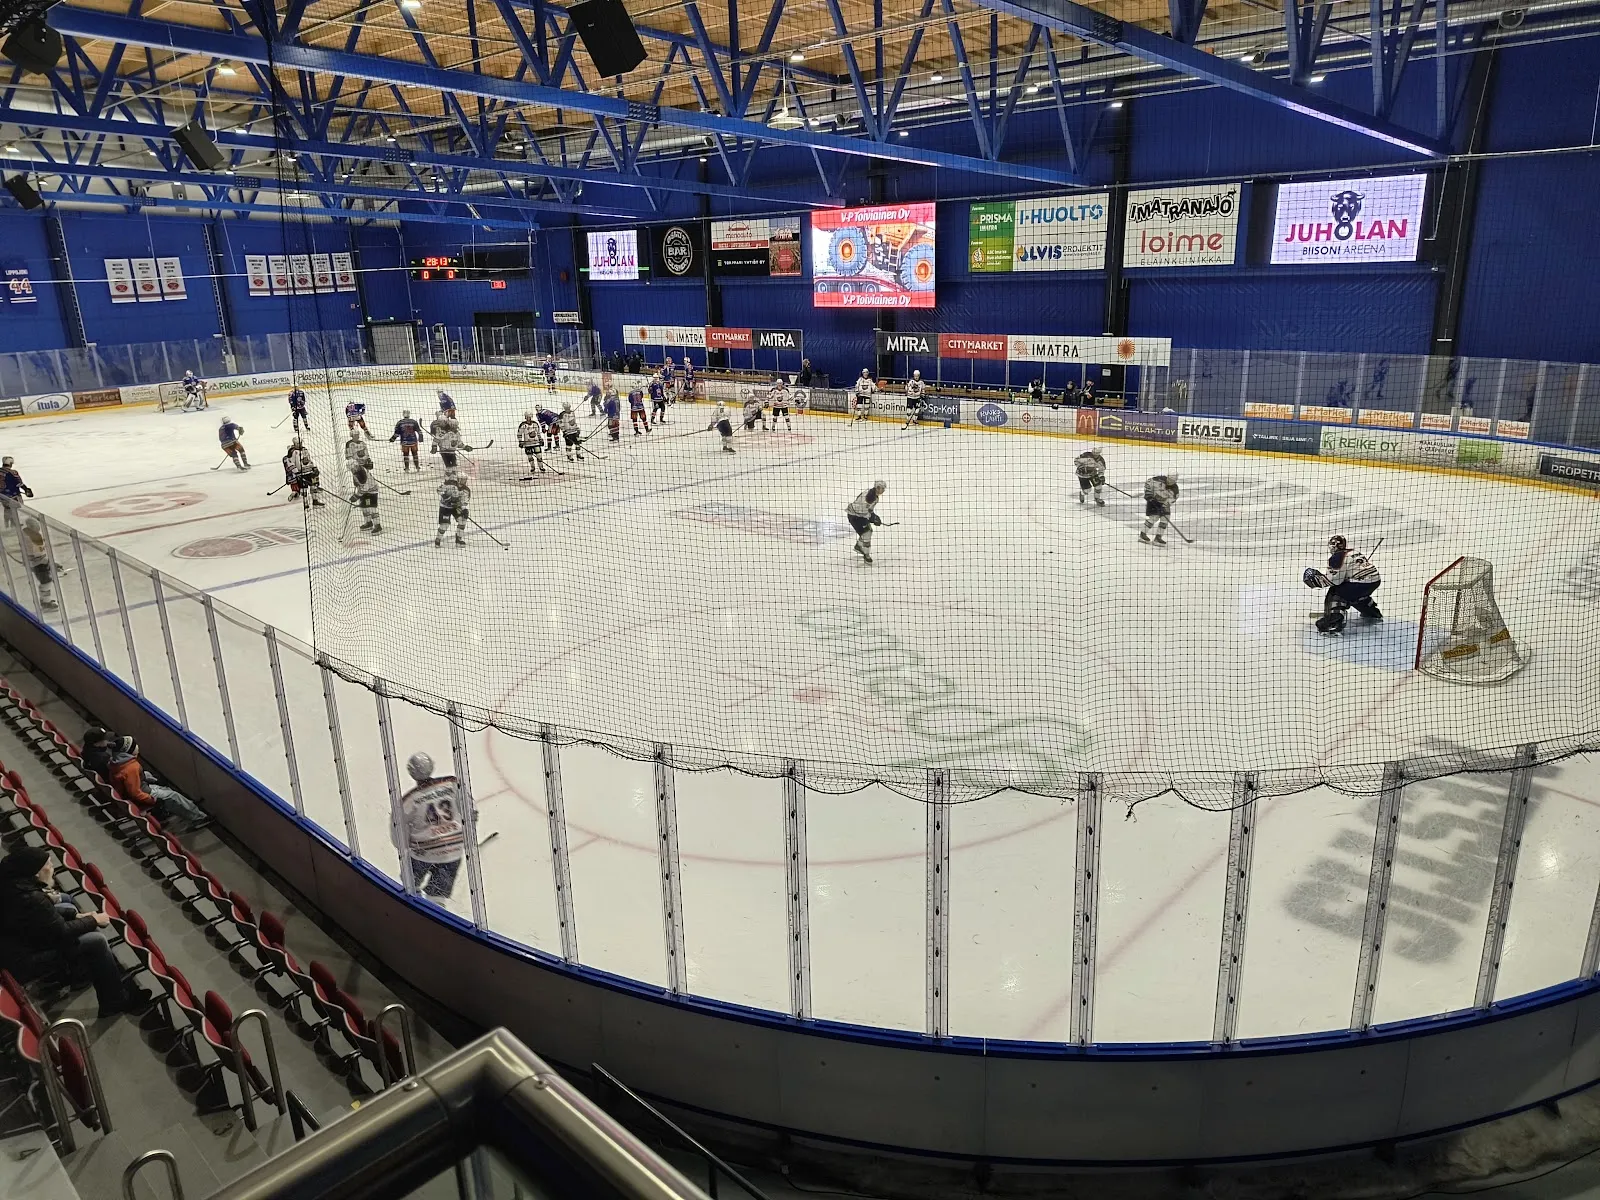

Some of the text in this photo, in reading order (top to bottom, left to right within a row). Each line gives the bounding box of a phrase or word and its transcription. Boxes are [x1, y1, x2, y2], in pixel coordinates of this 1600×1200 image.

[1129, 193, 1234, 223] IMATRANAJO
[841, 208, 910, 222] V-P Toiviainen Oy
[980, 213, 1013, 224] PRISMA
[1285, 218, 1408, 242] JUHOLAN
[1062, 244, 1103, 252] PROJEKTIT
[1140, 230, 1224, 254] loime
[667, 246, 687, 256] BAR
[1302, 244, 1386, 255] BIISONI AREENA
[426, 257, 448, 266] 28:13
[9, 277, 33, 294] 44
[843, 294, 911, 307] V-P Toiviainen Oy
[676, 331, 704, 344] IMATRA
[711, 332, 750, 342] CITYMARKET
[760, 332, 795, 347] MITRA
[886, 336, 929, 352] MITRA
[948, 339, 1004, 350] CITYMARKET
[1032, 343, 1079, 357] IMATRA
[219, 380, 249, 390] PRISMA
[928, 403, 958, 415] Sp-Koti
[1181, 423, 1221, 438] EKAS
[1339, 437, 1399, 452] REIKE OY
